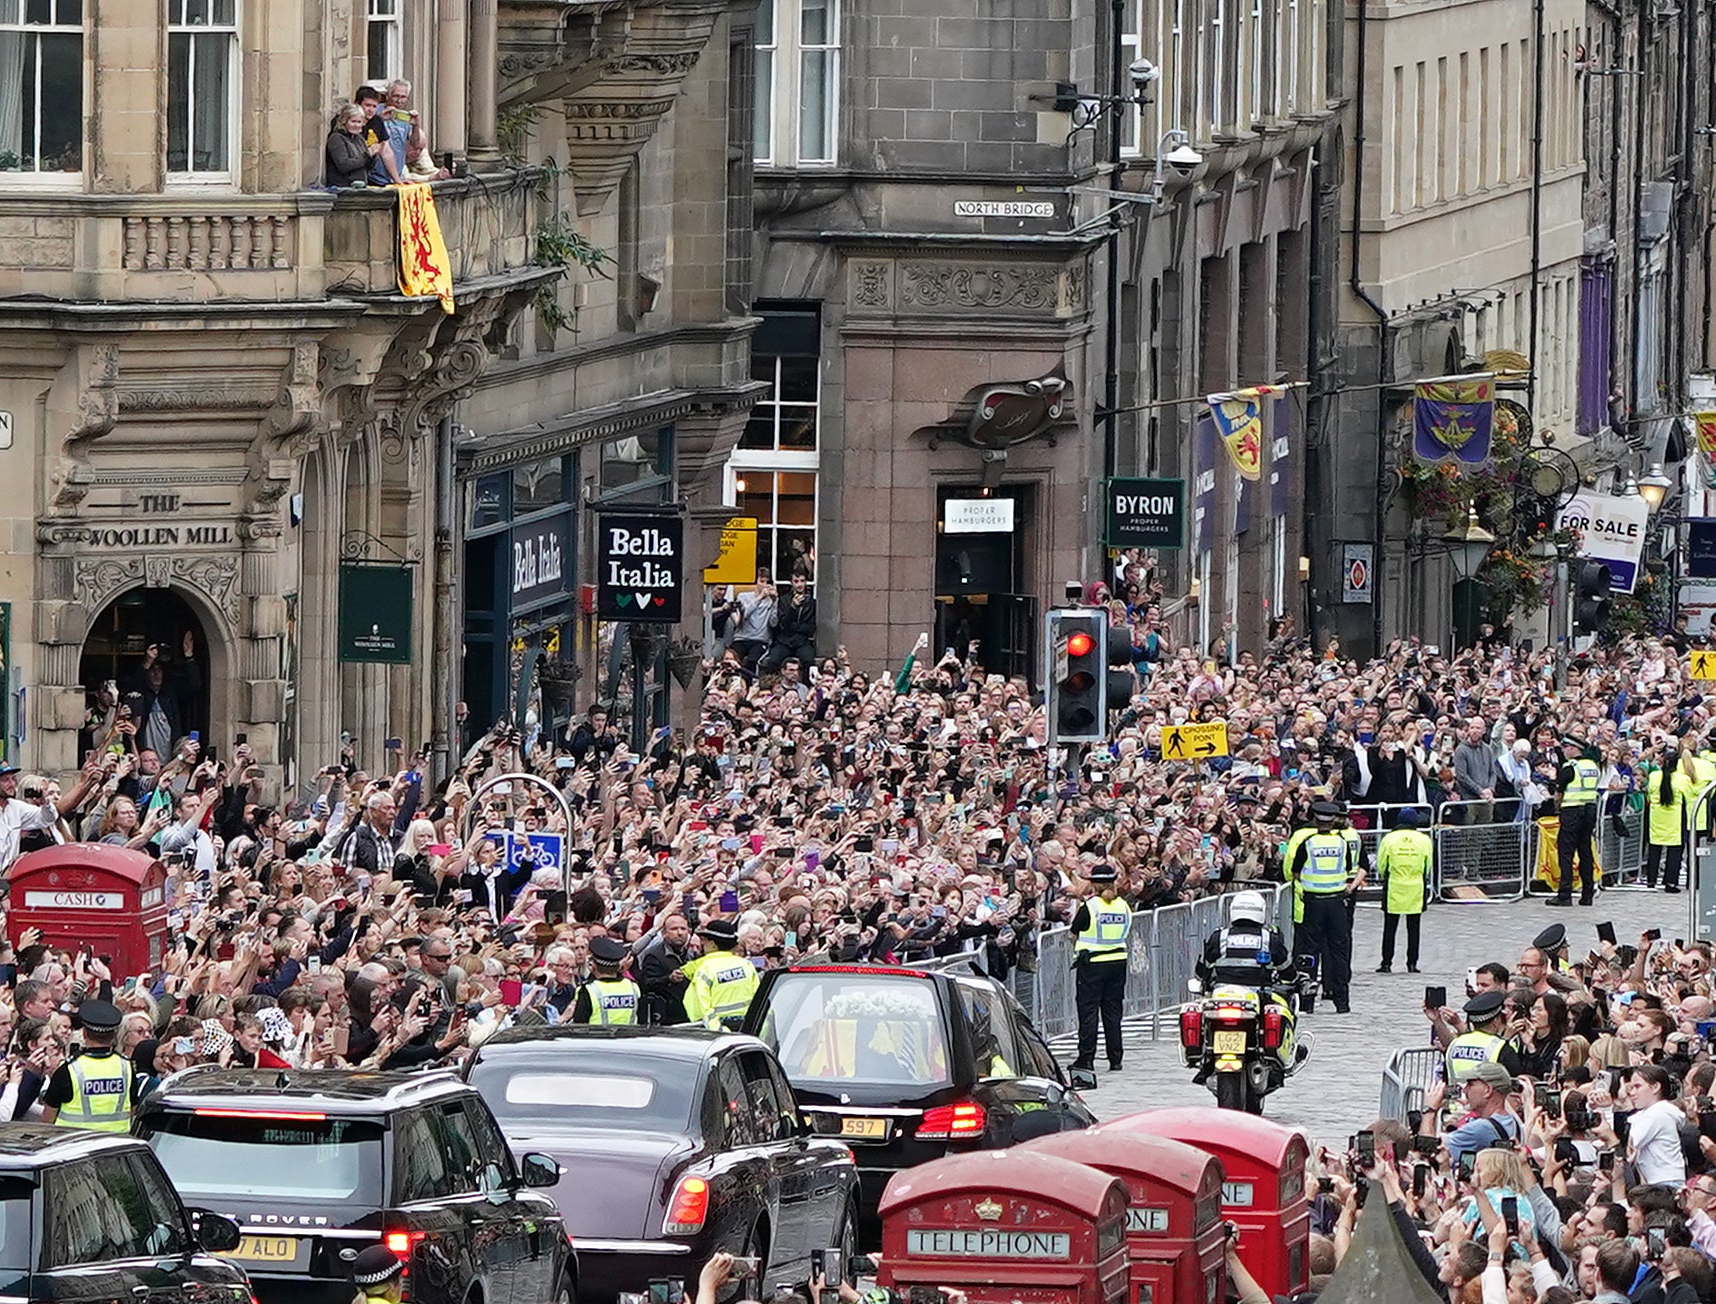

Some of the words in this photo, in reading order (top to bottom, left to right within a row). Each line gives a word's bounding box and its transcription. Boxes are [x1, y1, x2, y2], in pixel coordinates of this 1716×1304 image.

[957, 203, 999, 213] NORTH
[1004, 203, 1053, 215] BRIDGE
[139, 494, 182, 512] THE
[1116, 495, 1174, 515] BYRON
[1560, 515, 1590, 532] FOR
[1595, 519, 1639, 538] SALE
[88, 527, 180, 547] WOOLLEN
[187, 527, 233, 545] MILL
[608, 527, 674, 556] Bella
[513, 538, 537, 593] Bella
[537, 532, 562, 584] Italia
[607, 560, 675, 588] Italia
[1184, 724, 1224, 735] CROSSING
[1193, 733, 1216, 742] POINT
[1313, 847, 1342, 858] POLICE
[53, 892, 94, 906] CASH
[1100, 913, 1126, 925] POLICE
[1228, 934, 1261, 949] POLICE
[717, 967, 746, 983] POLICE
[604, 995, 635, 1009] POLICE
[1453, 1046, 1486, 1060] POLICE
[85, 1079, 124, 1094] POLICE
[846, 1120, 875, 1134] 597
[250, 1214, 327, 1226] ROVER
[252, 1239, 288, 1257] ALO
[915, 1231, 1067, 1255] TELEPHONE
